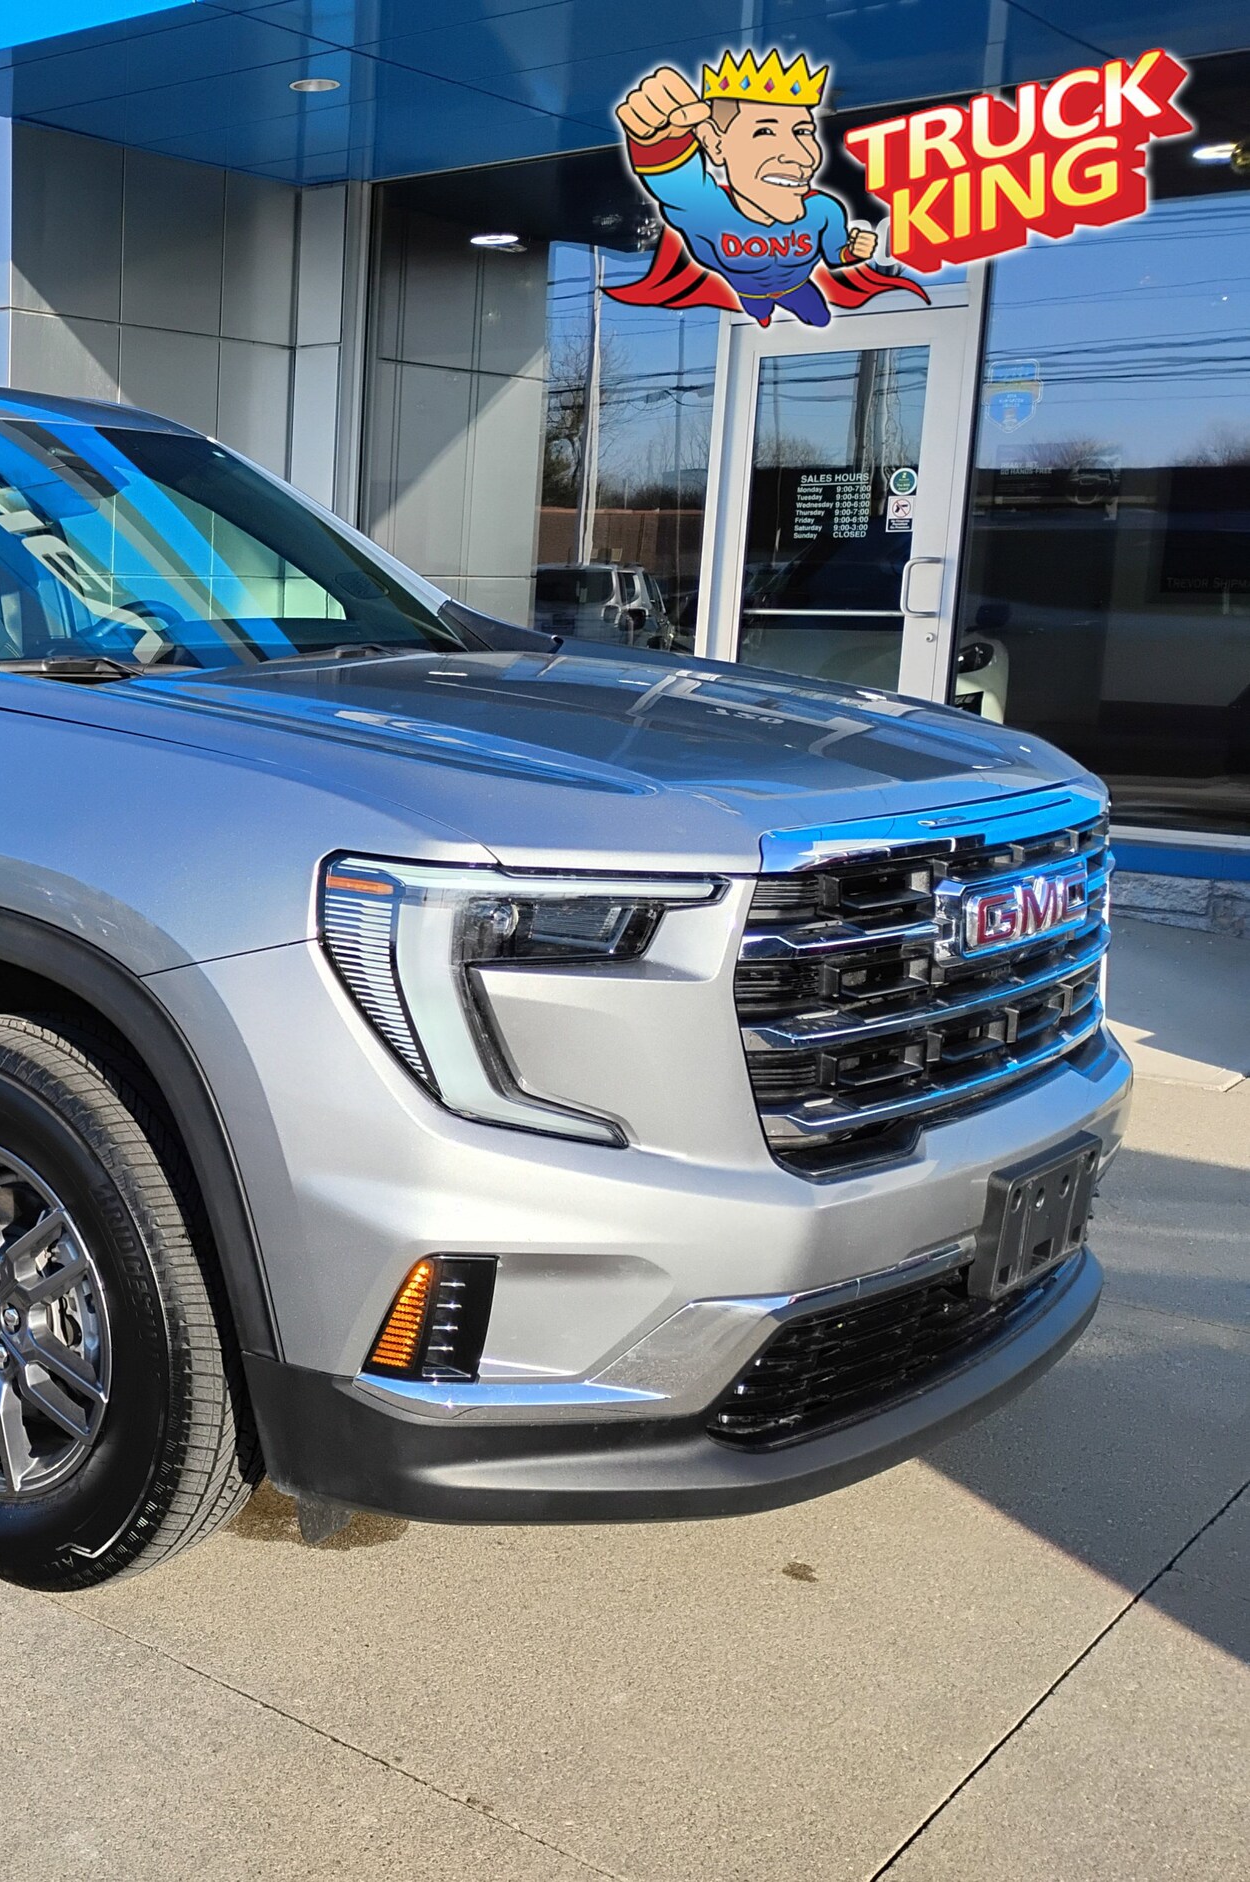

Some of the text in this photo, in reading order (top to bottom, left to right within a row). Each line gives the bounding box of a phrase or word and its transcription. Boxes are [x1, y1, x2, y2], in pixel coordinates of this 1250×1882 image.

[801, 472, 869, 484] SALES HOURS
[797, 486, 823, 494] Monday
[796, 494, 823, 502] Tuesday
[796, 501, 833, 509] Wednesday
[795, 509, 825, 517] Thursday
[794, 524, 822, 532] Saturday
[793, 532, 817, 540] Sunday
[967, 872, 1088, 945] GMC
